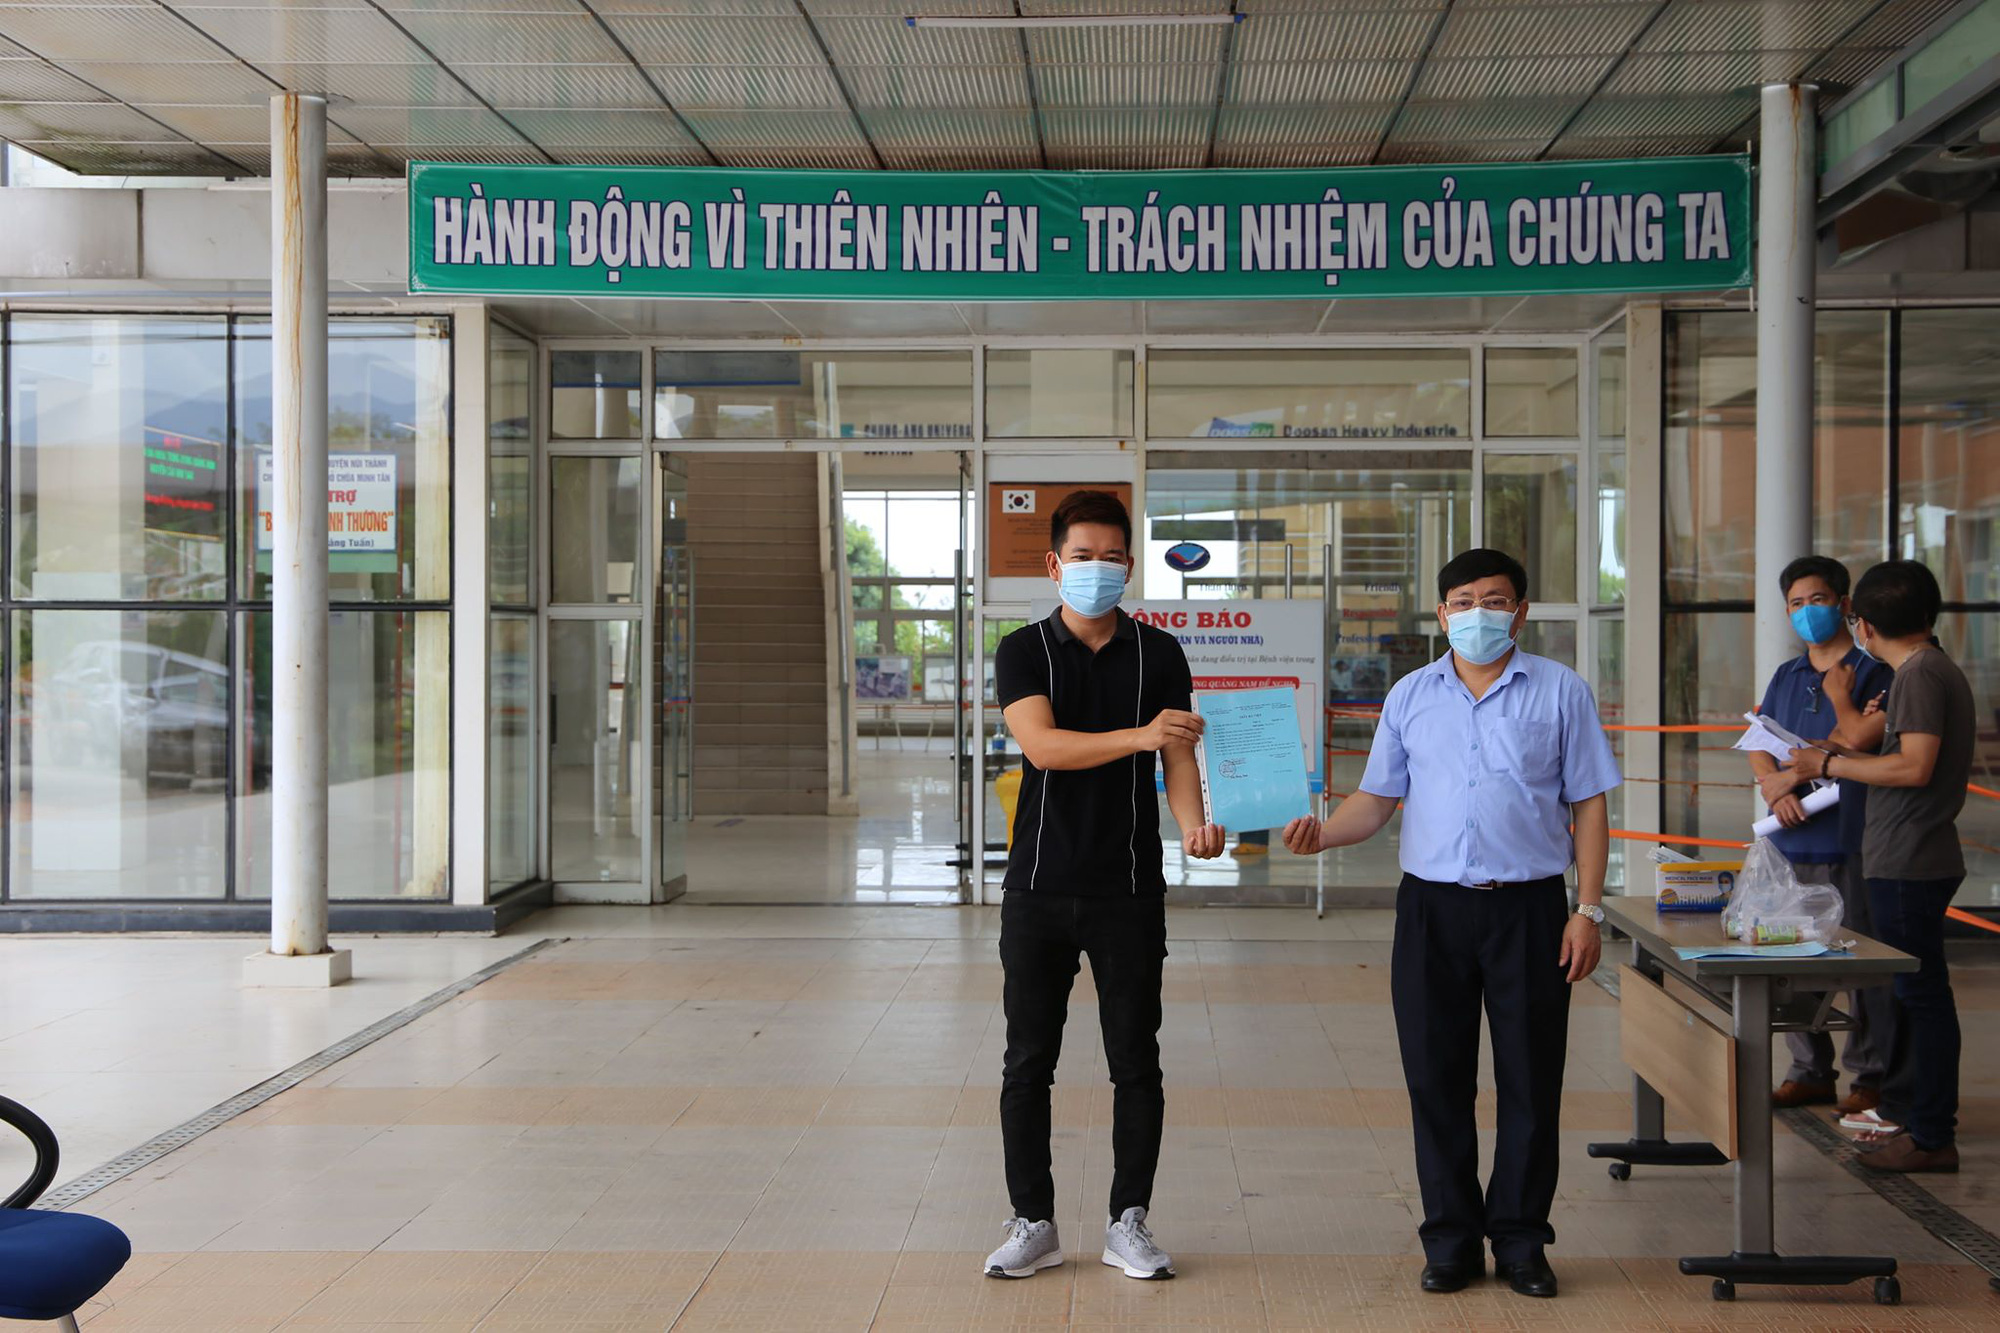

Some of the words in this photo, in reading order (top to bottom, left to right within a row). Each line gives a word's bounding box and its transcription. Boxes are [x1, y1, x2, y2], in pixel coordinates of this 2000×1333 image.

[432, 183, 557, 267] HÀNH
[566, 185, 692, 284] ĐỘNG
[703, 187, 747, 270] VÌ
[759, 189, 889, 271] THIÊN
[901, 190, 1039, 272] NHIÊN
[1053, 236, 1069, 252] -
[1081, 191, 1227, 273] TRÁCH
[1239, 187, 1388, 286] NHIỆM
[1403, 176, 1496, 269] CỦA
[1508, 181, 1666, 265] CHÚNG
[1677, 191, 1731, 260] TA
[1283, 424, 1337, 438] Doosan
[1342, 424, 1388, 438] Heavy
[1196, 608, 1253, 628] BÁO
